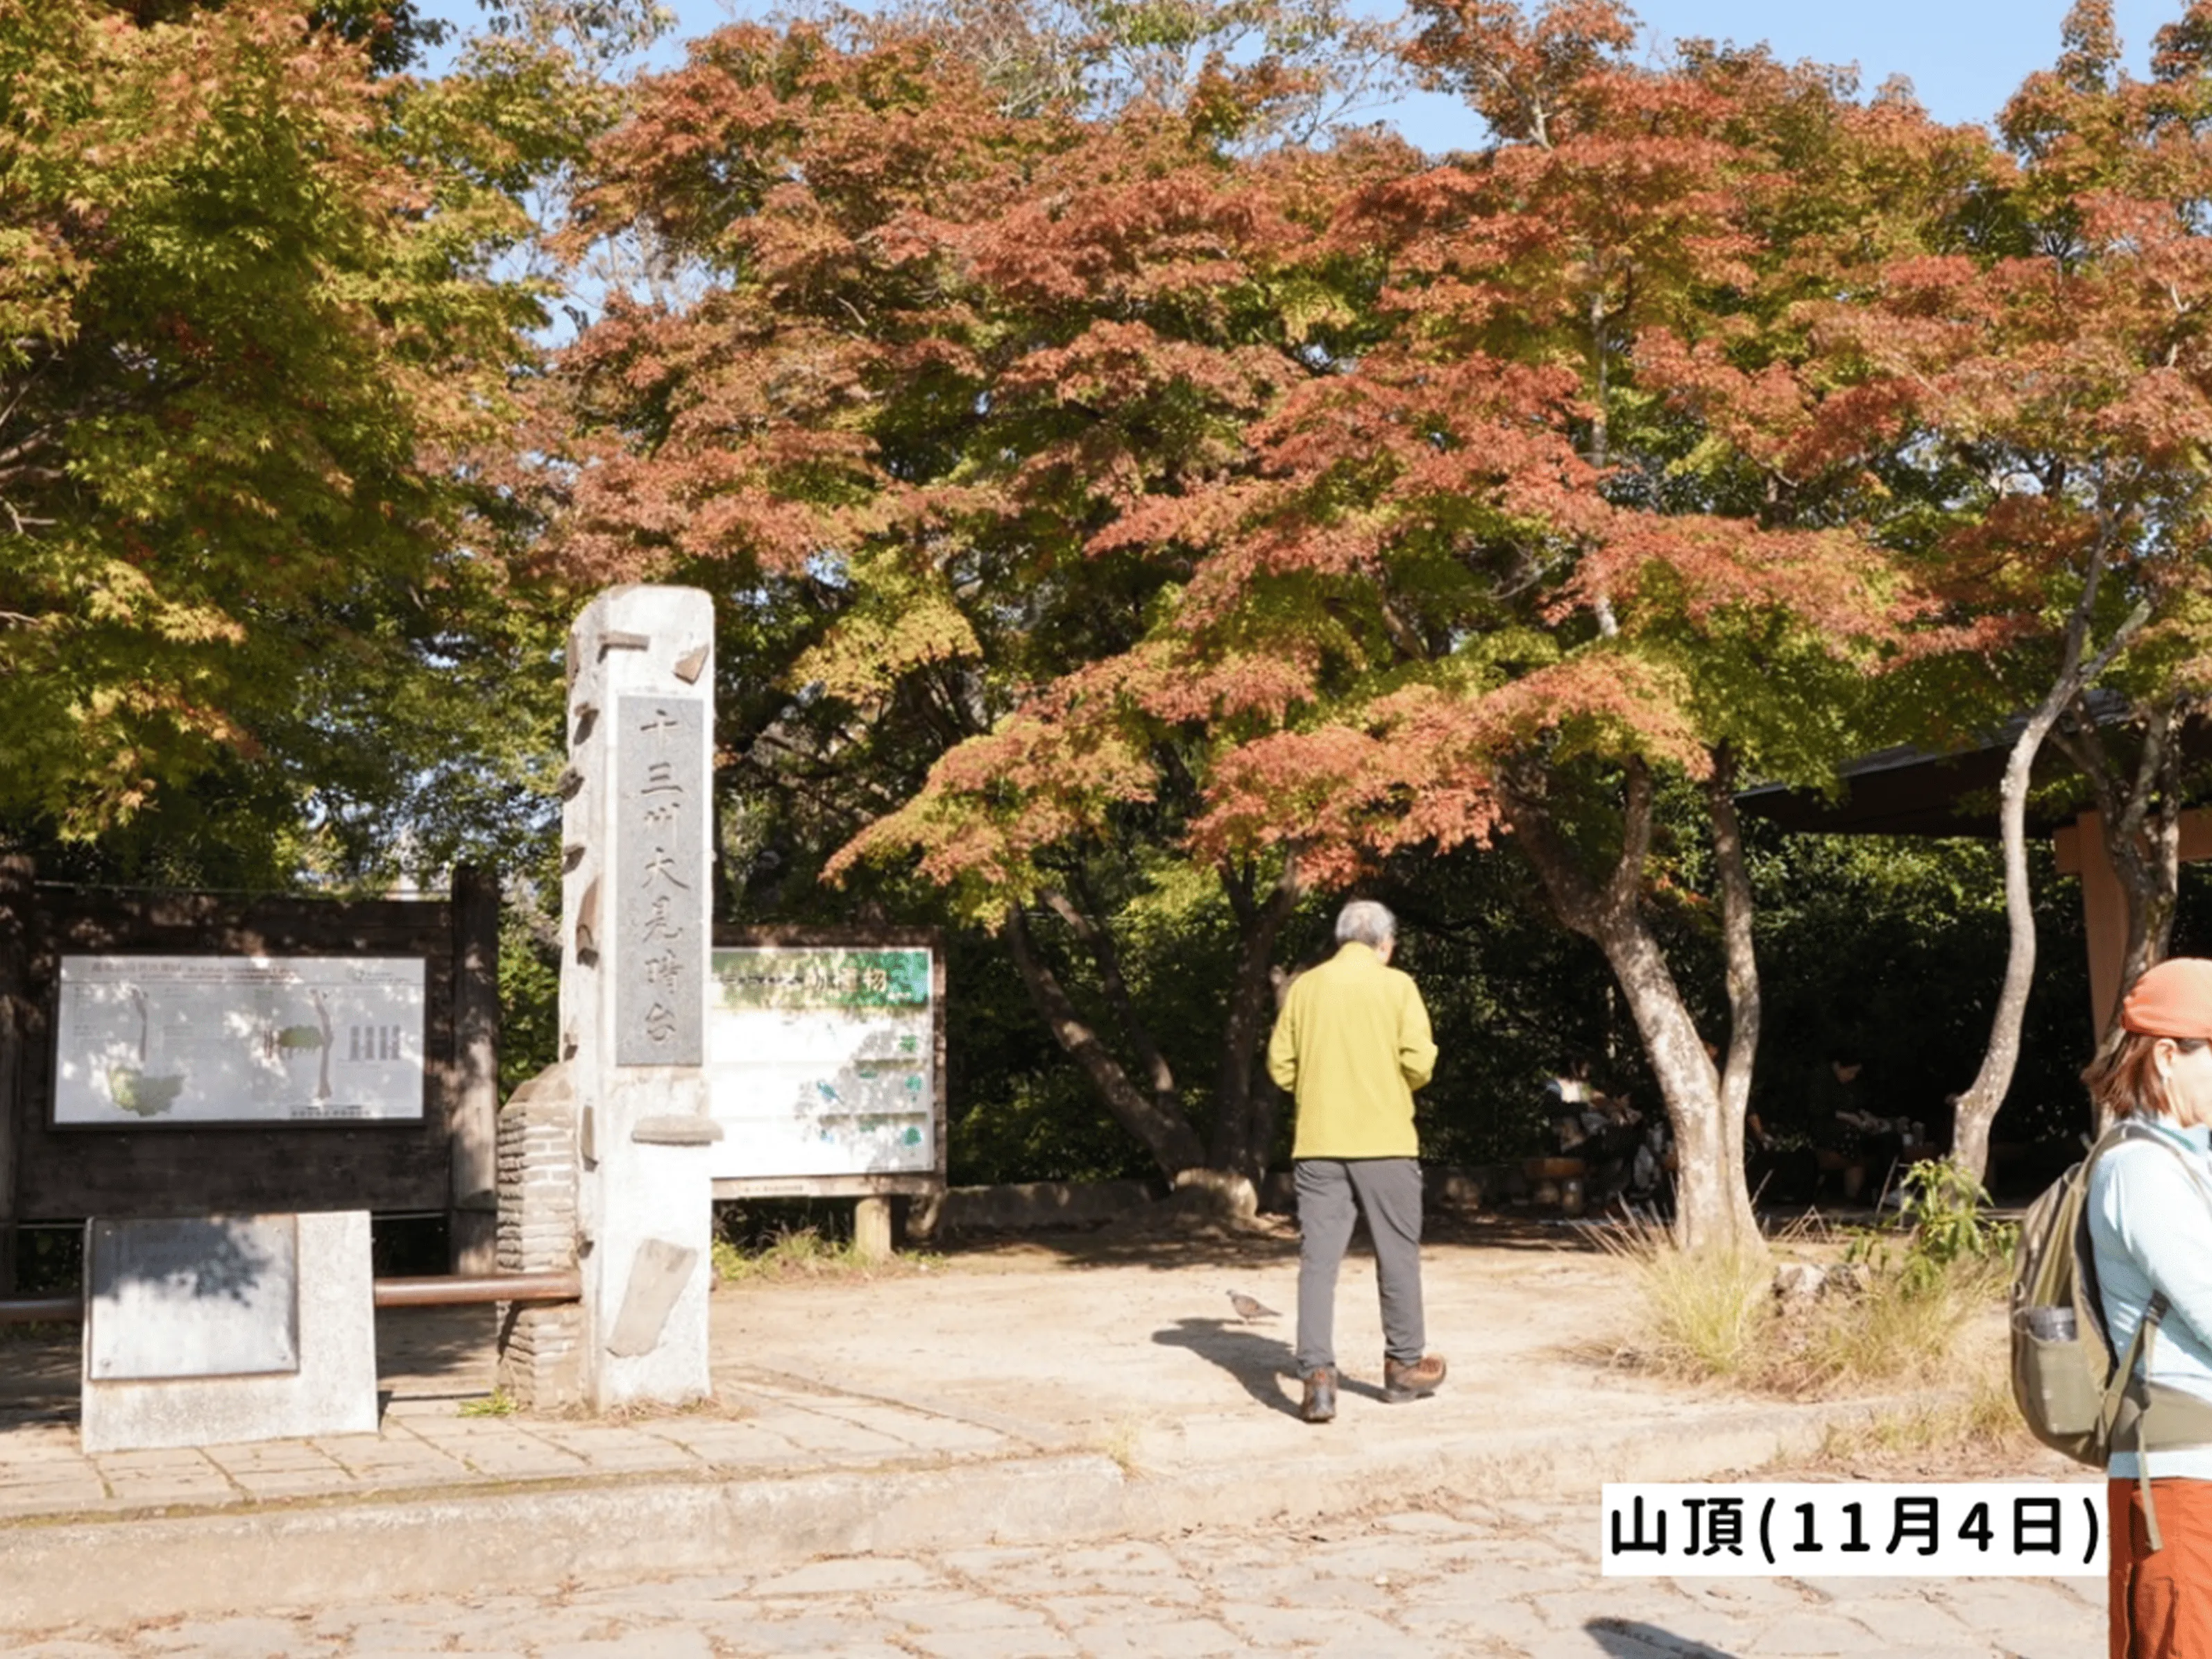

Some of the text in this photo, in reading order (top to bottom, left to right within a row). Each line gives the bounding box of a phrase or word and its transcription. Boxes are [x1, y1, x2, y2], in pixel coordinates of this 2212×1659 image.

[640, 710, 689, 1041] 十三州大見晴台
